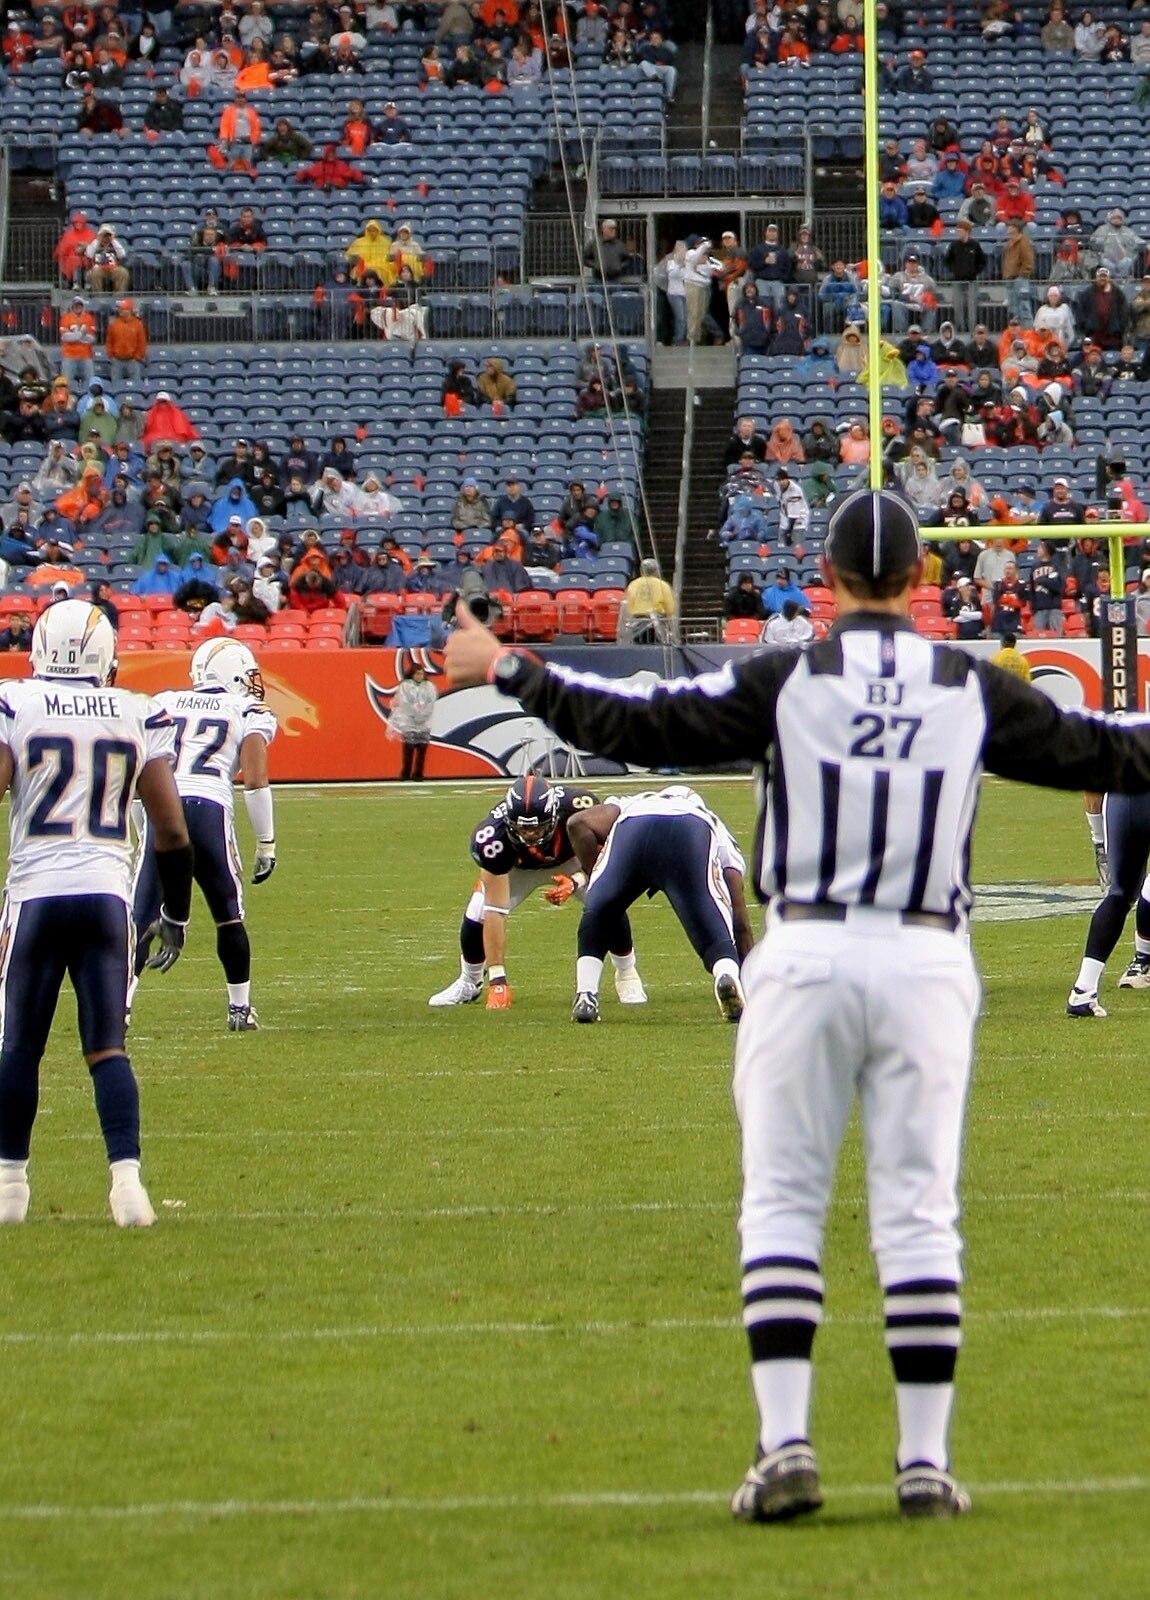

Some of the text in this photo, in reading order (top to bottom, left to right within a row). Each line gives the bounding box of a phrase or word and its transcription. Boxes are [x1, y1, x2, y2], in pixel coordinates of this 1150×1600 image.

[1111, 626, 1137, 720] BRON
[45, 694, 121, 719] McCREE
[176, 696, 223, 711] HARRIS
[867, 684, 903, 706] BJ
[849, 713, 922, 760] 27
[27, 734, 136, 841] 20
[475, 825, 504, 859] 88
